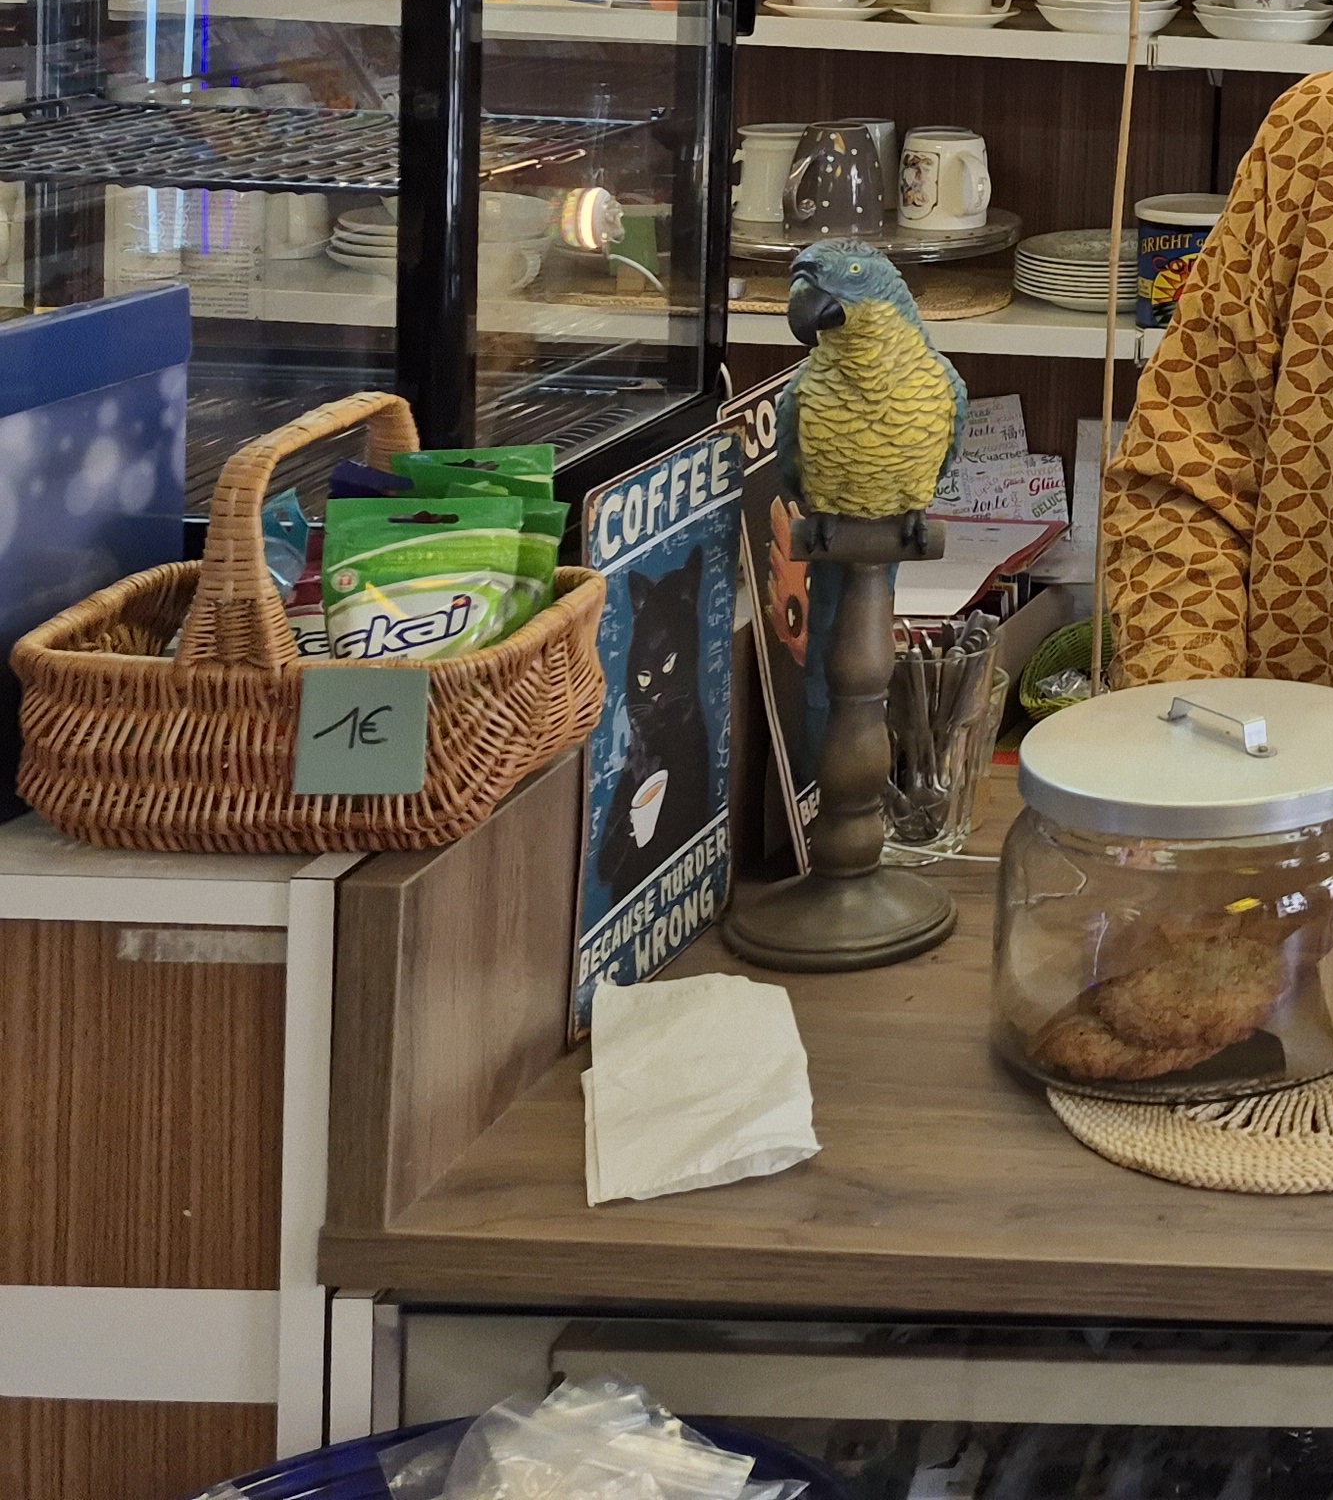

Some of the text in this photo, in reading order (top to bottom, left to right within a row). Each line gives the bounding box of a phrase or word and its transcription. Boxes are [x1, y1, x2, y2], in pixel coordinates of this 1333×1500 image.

[1142, 234, 1192, 254] BRIGHT
[600, 437, 732, 560] COFFEE
[313, 705, 392, 748] 1€
[660, 827, 730, 907] MURDER
[578, 889, 657, 986] BECAUSE
[635, 874, 714, 979] WRONG
